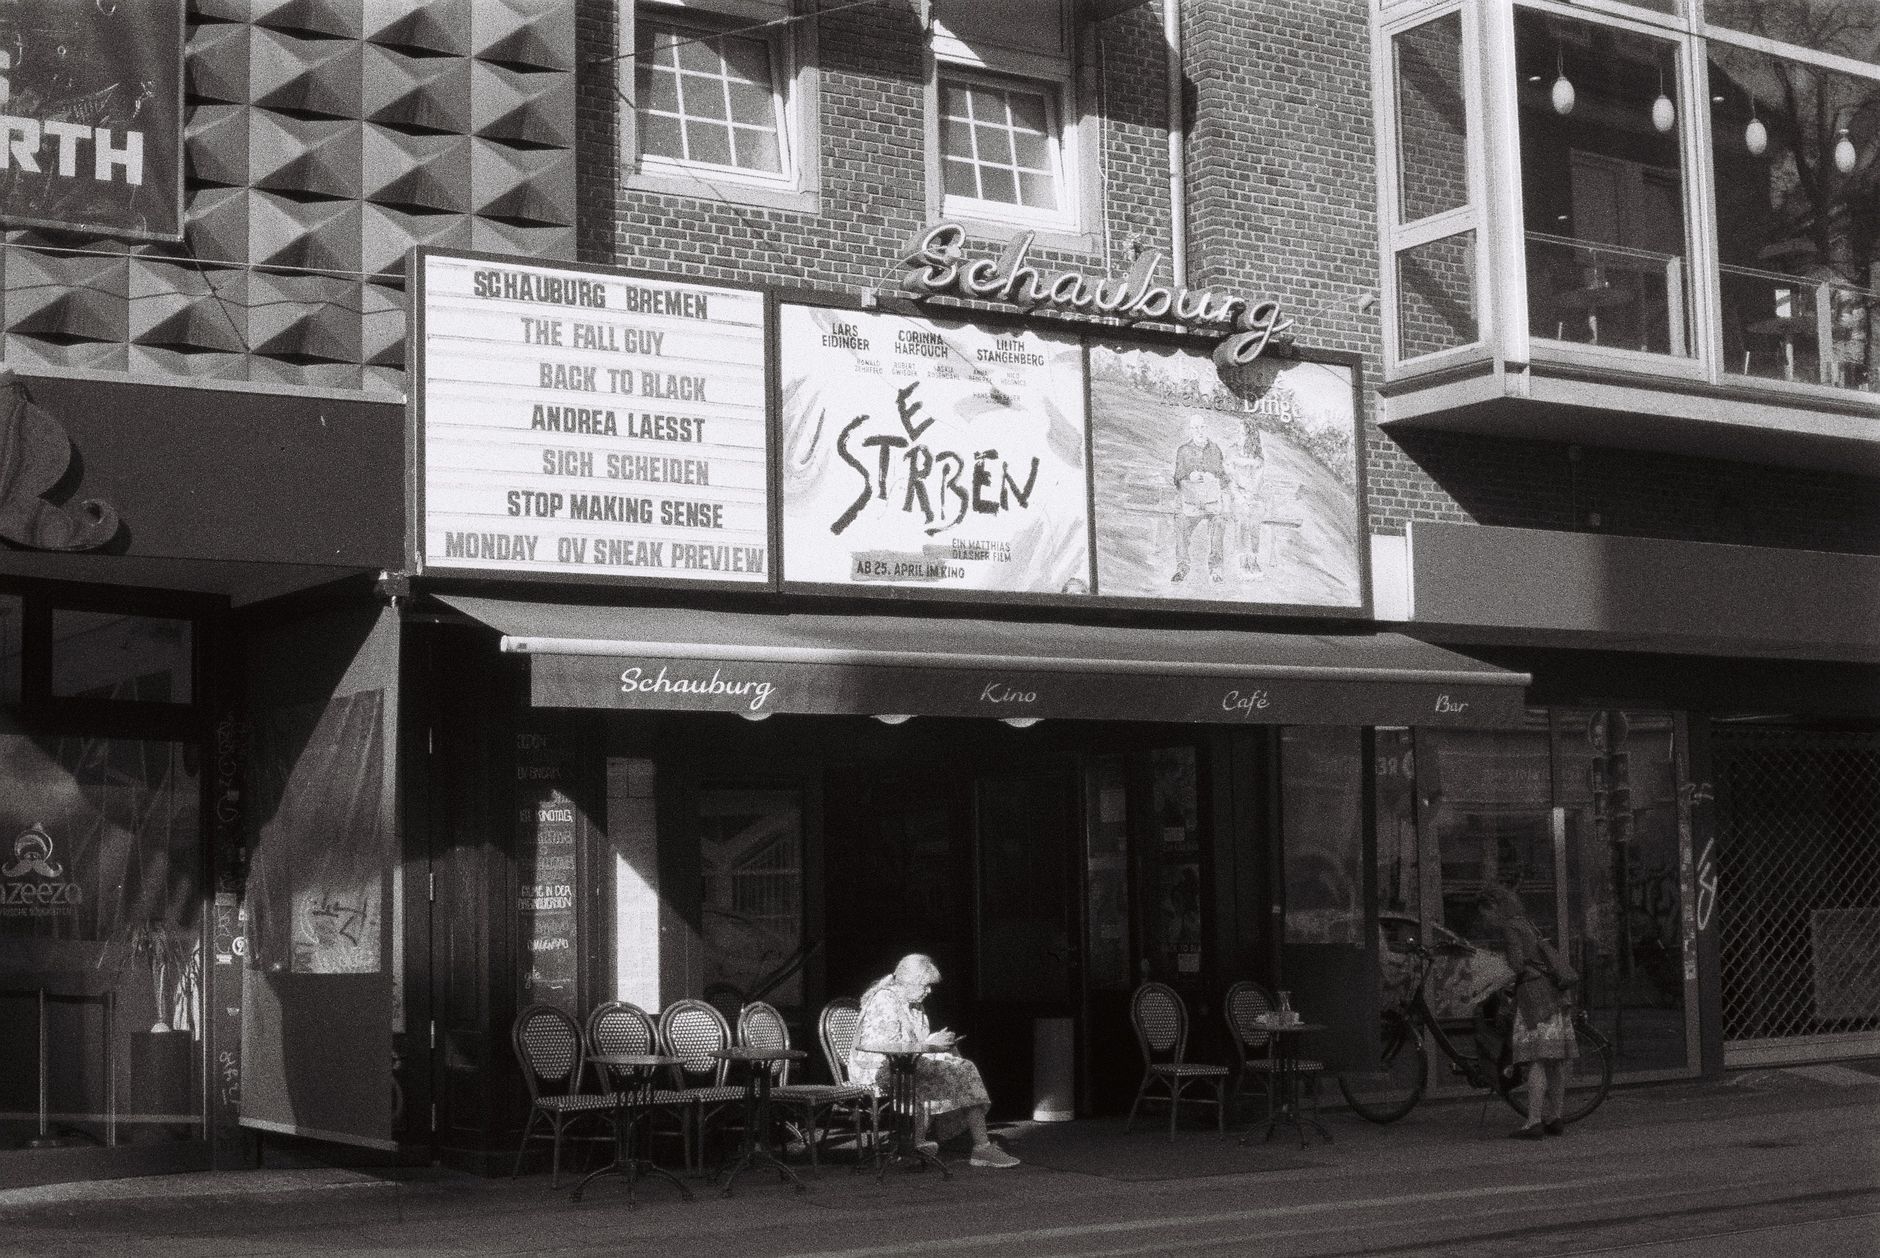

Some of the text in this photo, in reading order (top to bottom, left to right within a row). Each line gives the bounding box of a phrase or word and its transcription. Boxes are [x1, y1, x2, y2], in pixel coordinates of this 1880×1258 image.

[474, 271, 708, 319] SCHAUBURG BREMEN
[904, 222, 1295, 368] Schauburg
[521, 317, 665, 356] THE FALL GUY
[832, 322, 859, 337] LARS
[898, 330, 944, 345] CORINNA
[822, 335, 870, 351] EIDINGER
[894, 342, 948, 359] HARFOUCH
[996, 339, 1025, 352] LILITH
[977, 349, 1045, 367] STANGENBERG
[540, 363, 706, 401] BACK TO BLACK
[531, 404, 706, 443] ANDREA LAESST
[542, 449, 709, 485] SICH SCHEIDEN
[507, 490, 723, 528] STOP MAKING SENSE
[445, 531, 764, 573] MONDAY OV SNEAK PREVIEW
[952, 538, 1011, 552] EIN MATTHIAS
[992, 553, 1012, 563] FILM
[857, 561, 965, 579] AB 25. APRIL IM KINO
[621, 666, 776, 710] Schauburg
[979, 681, 1037, 703] Kino
[1222, 690, 1270, 717] Café
[1435, 693, 1469, 713] Bar
